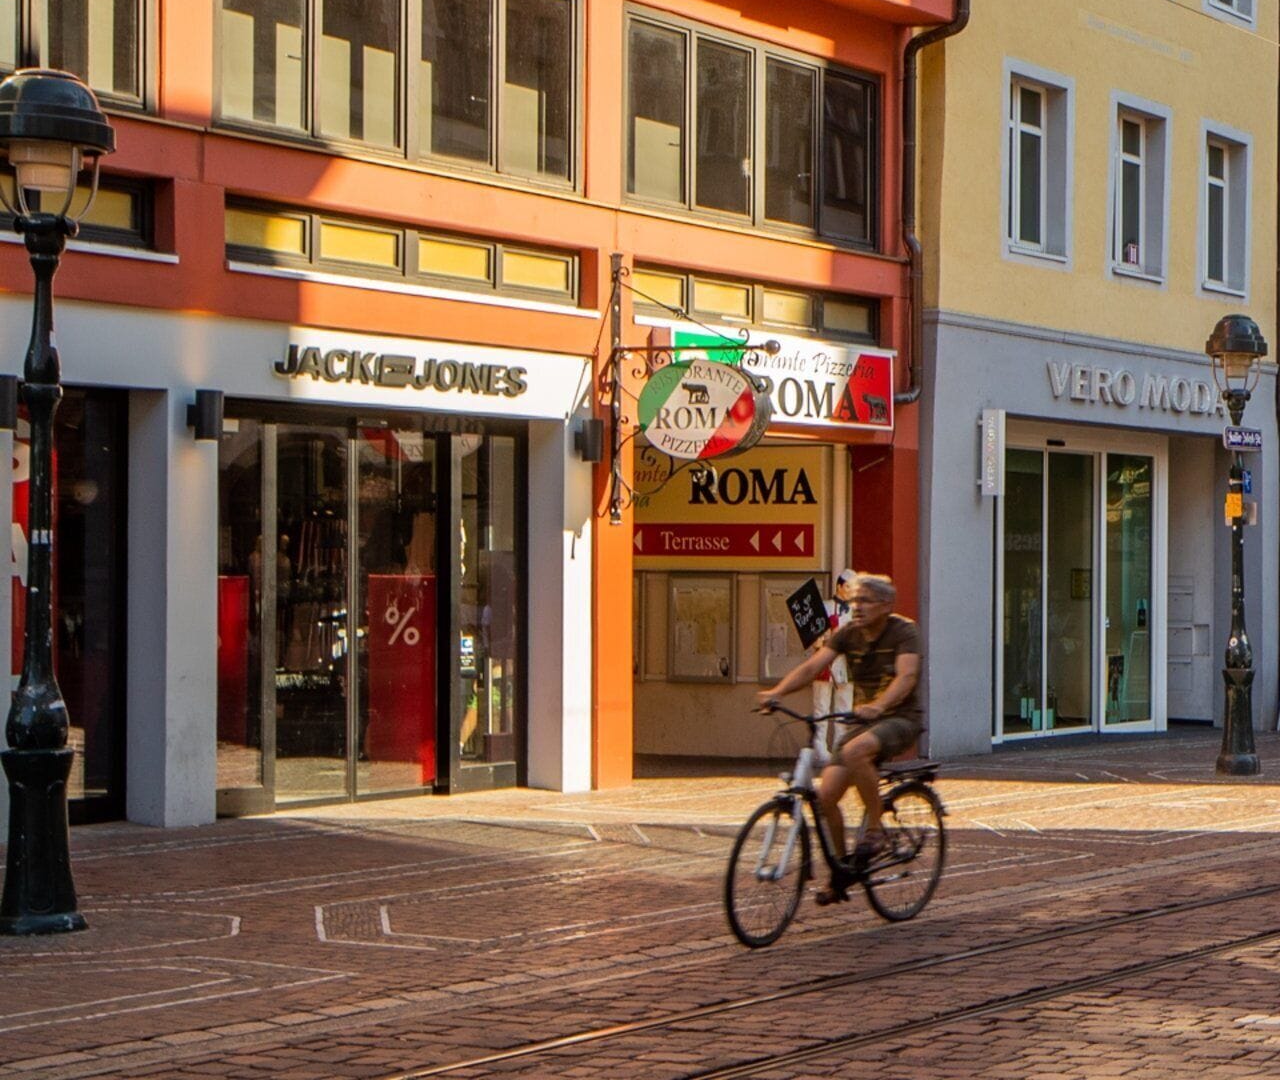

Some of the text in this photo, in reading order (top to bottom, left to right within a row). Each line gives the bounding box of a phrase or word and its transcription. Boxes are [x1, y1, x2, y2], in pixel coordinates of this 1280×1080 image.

[813, 352, 875, 379] Pizzeria
[649, 366, 743, 394] RISTORANTE
[1046, 361, 1225, 417] VERO MODA
[655, 406, 736, 430] ROMA
[688, 467, 817, 505] ROMA
[661, 531, 730, 551] Terrasse
